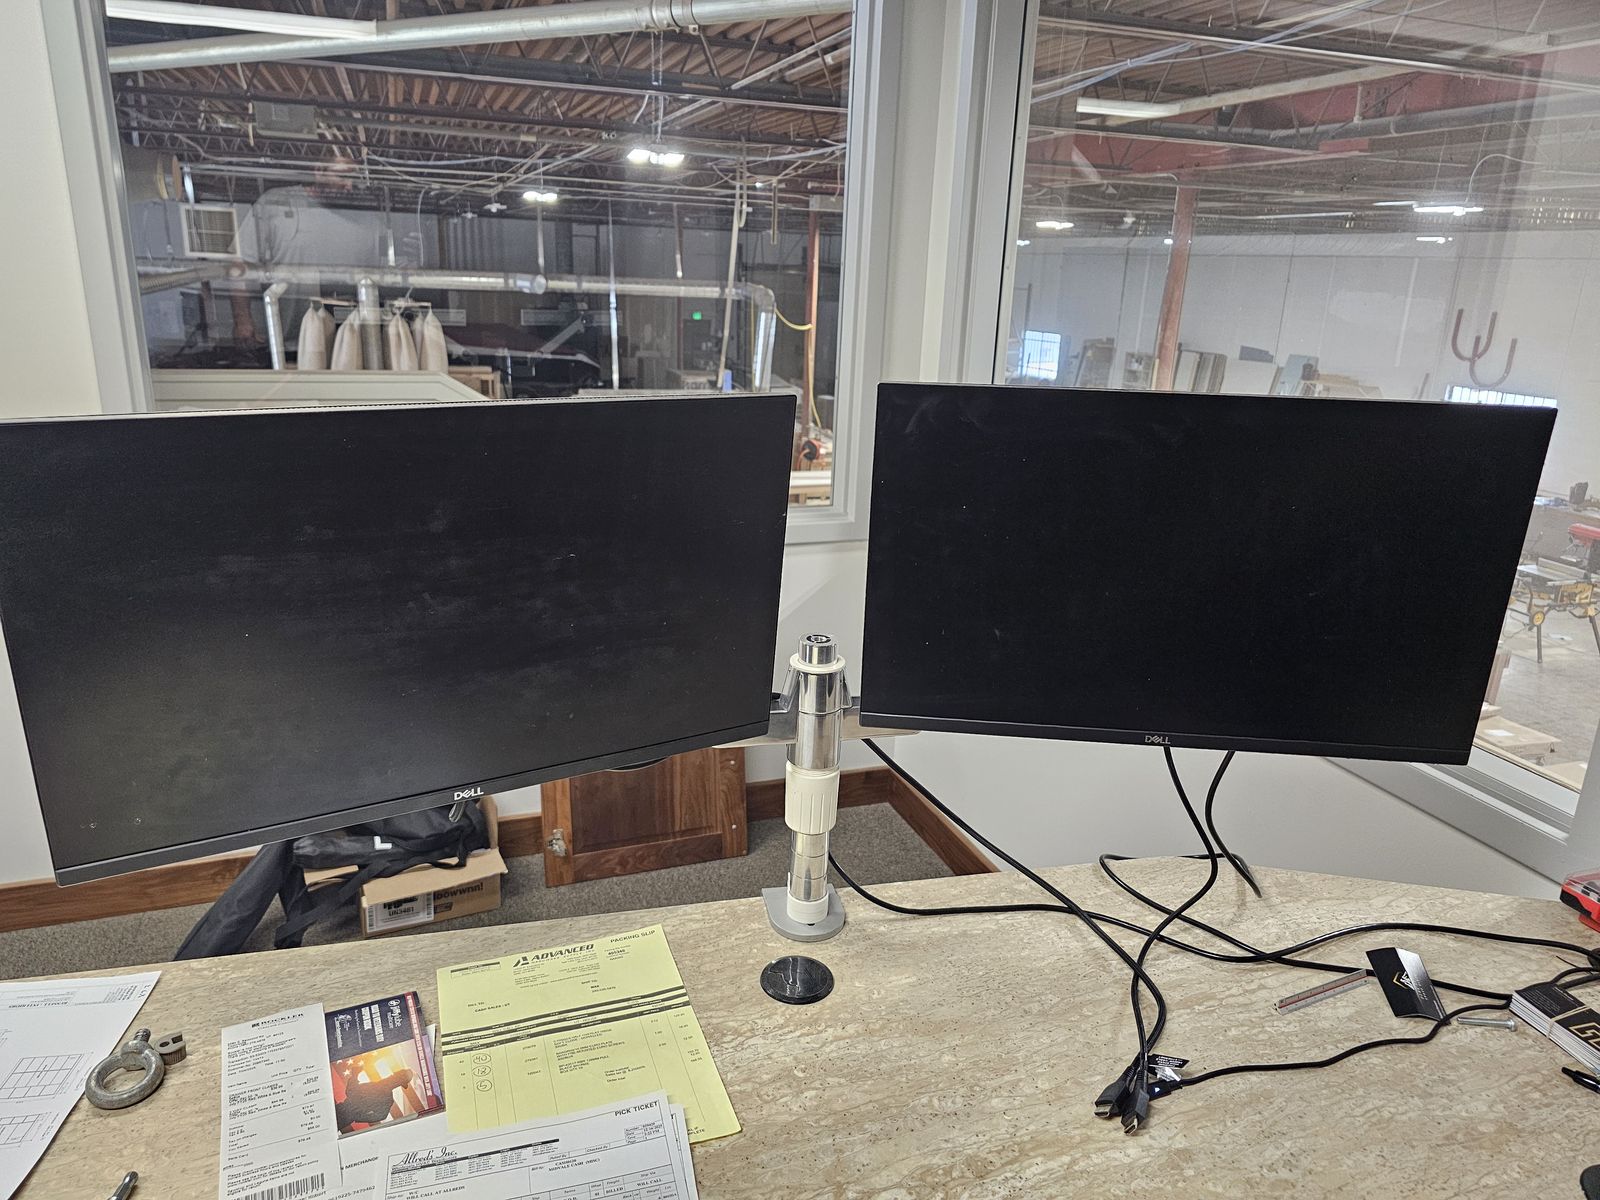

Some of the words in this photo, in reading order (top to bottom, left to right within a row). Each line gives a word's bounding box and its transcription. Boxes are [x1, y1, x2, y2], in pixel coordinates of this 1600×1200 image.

[1145, 735, 1171, 745] DELL
[453, 787, 484, 801] DELL
[610, 933, 640, 943] PACKING
[640, 929, 656, 938] SLIP
[531, 943, 595, 962] ADVANCED
[475, 1055, 488, 1063] 40
[479, 1081, 488, 1089] 5
[614, 1106, 632, 1117] PICK
[632, 1101, 659, 1112] TICKET
